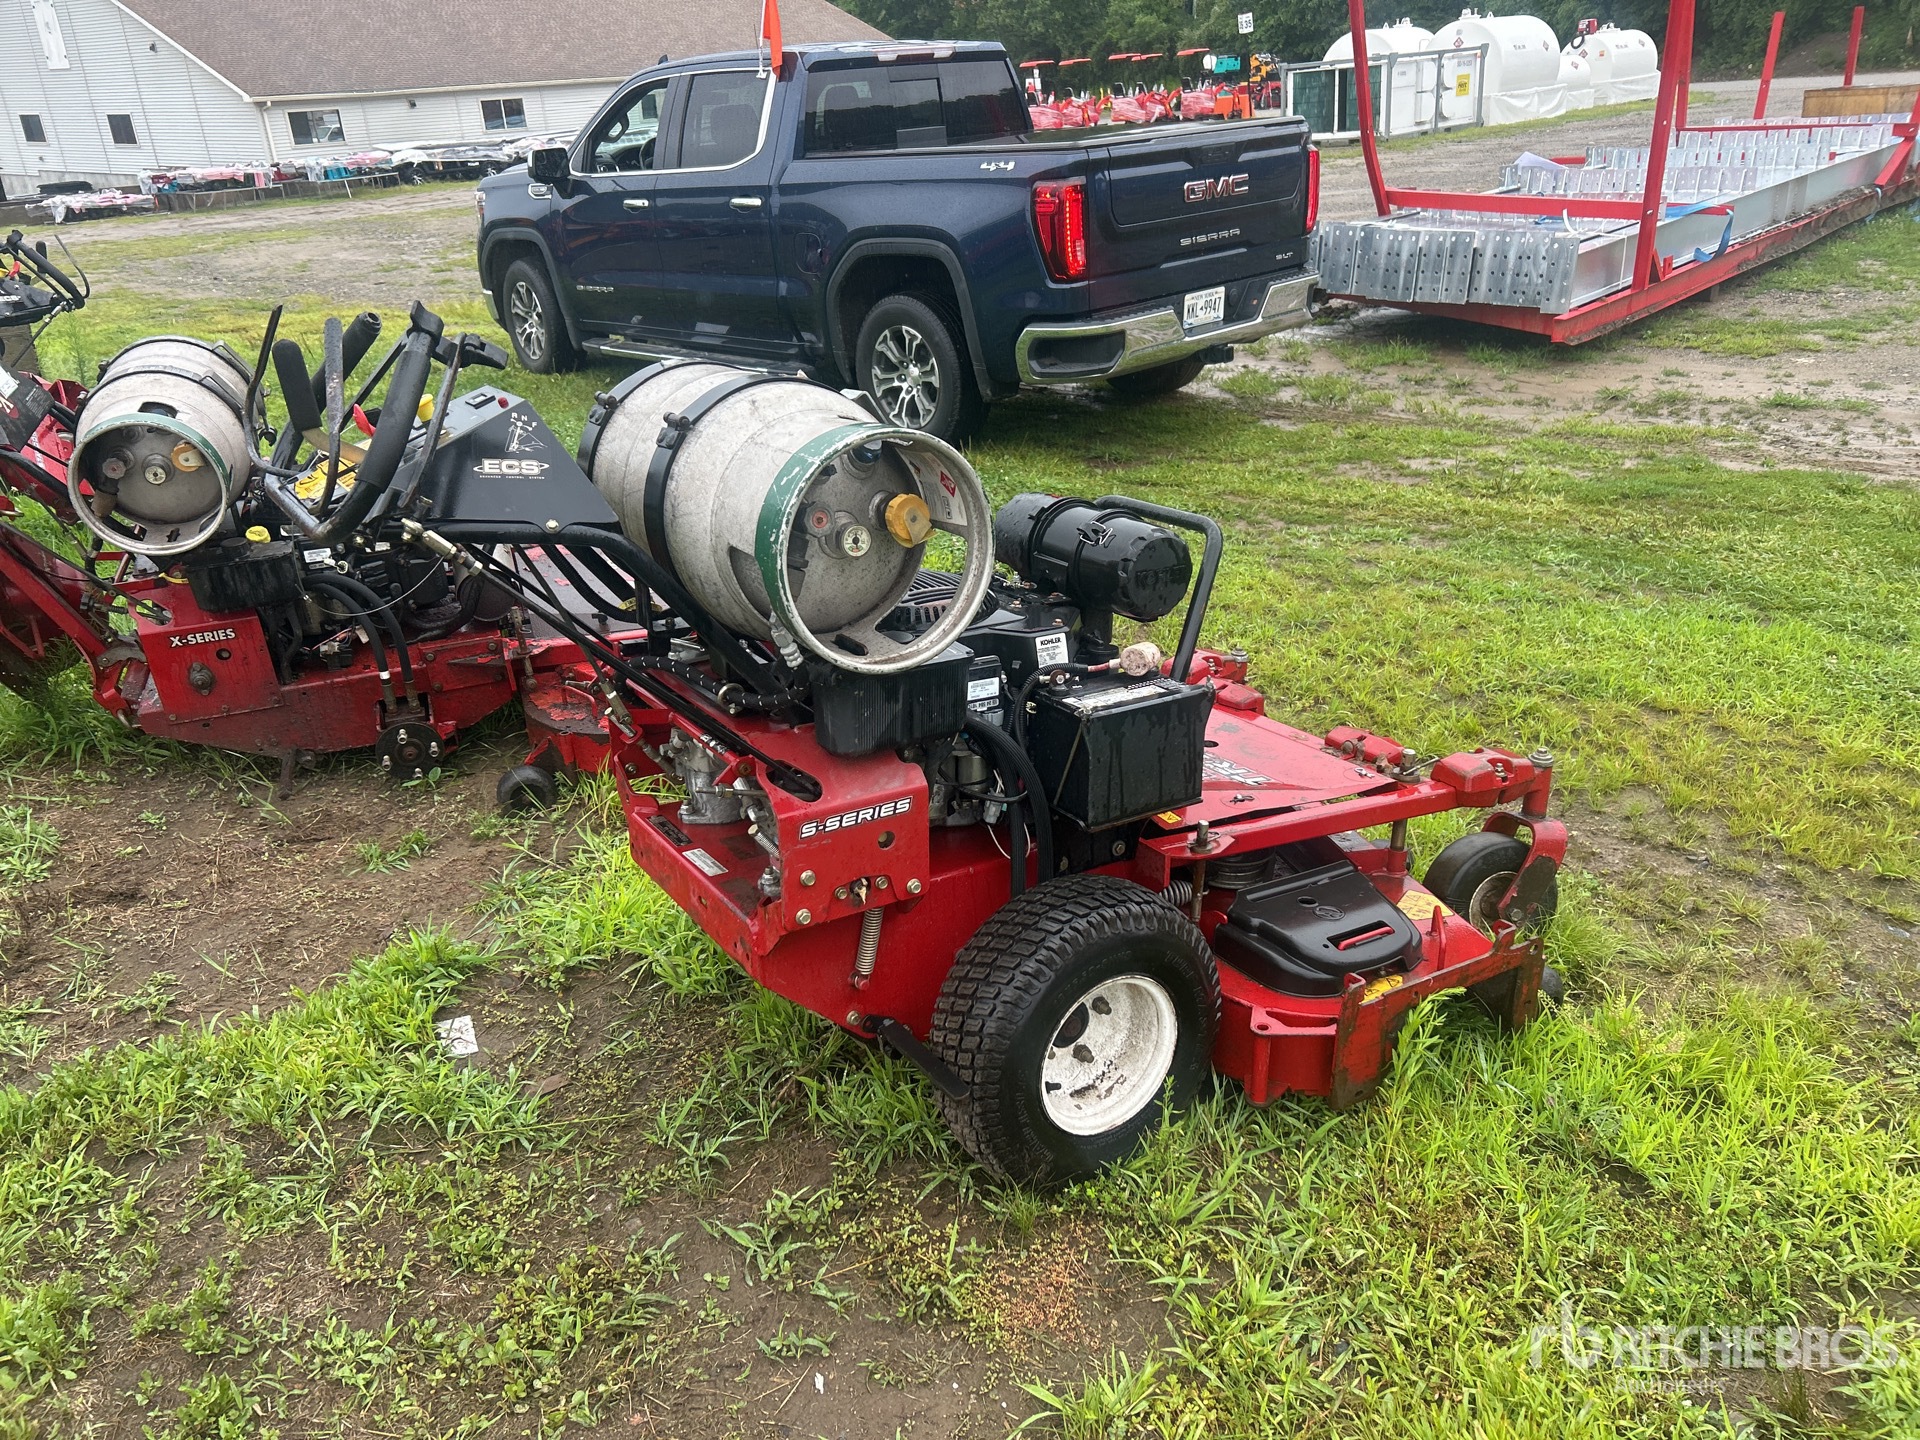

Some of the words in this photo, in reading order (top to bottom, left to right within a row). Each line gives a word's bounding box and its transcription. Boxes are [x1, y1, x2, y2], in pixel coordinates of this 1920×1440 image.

[1183, 173, 1249, 203] GMC
[1180, 228, 1240, 246] SIERRA
[1275, 251, 1294, 260] SLT
[482, 458, 541, 475] ECS
[169, 627, 236, 648] X-SERIES
[1040, 636, 1062, 647] KOHLER
[799, 796, 913, 840] S-SERIES
